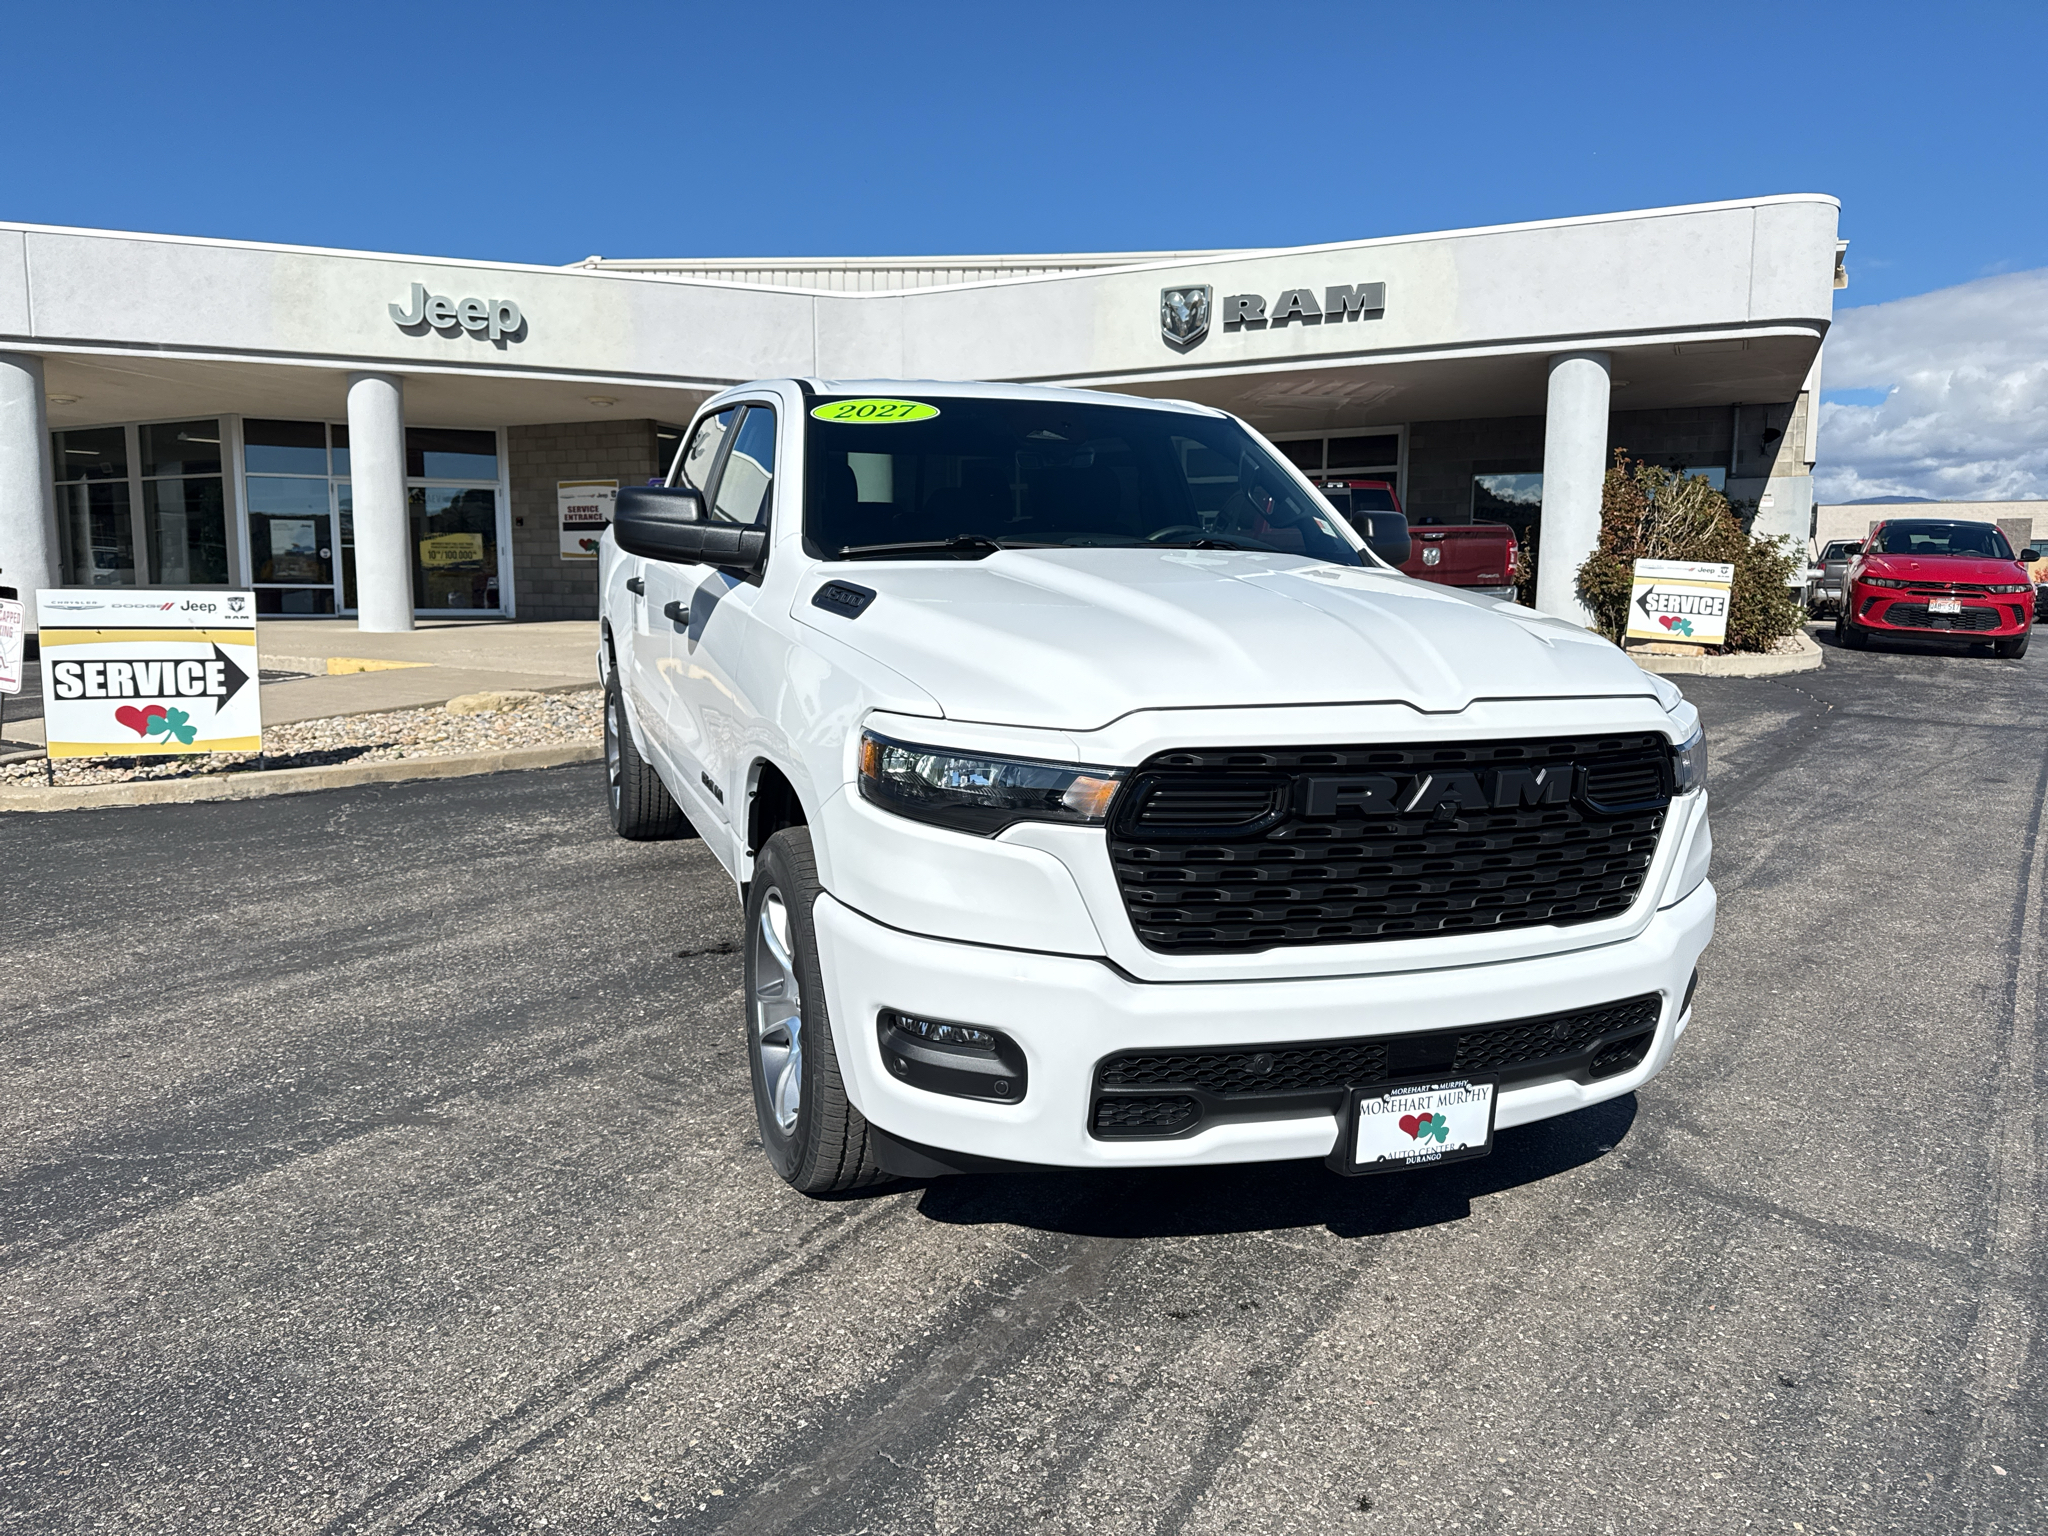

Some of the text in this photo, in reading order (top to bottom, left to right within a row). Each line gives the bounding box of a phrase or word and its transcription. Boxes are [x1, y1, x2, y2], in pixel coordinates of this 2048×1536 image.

[388, 282, 522, 340] Jeep
[1223, 282, 1386, 325] RAM
[833, 404, 917, 419] 2027
[564, 513, 603, 521] ENTRANCE
[567, 505, 599, 513] SERVICE
[826, 586, 864, 607] 1500
[1645, 593, 1724, 616] SERVICE
[181, 600, 217, 613] Jeep
[54, 660, 227, 698] SERVICE
[1305, 765, 1574, 816] RAM
[1390, 1080, 1468, 1096] MOREHART MURPHY
[1360, 1086, 1490, 1116] MOREHART MURPHY
[1387, 1143, 1455, 1160] AUTO CENTER
[1405, 1153, 1442, 1165] DURANGO
